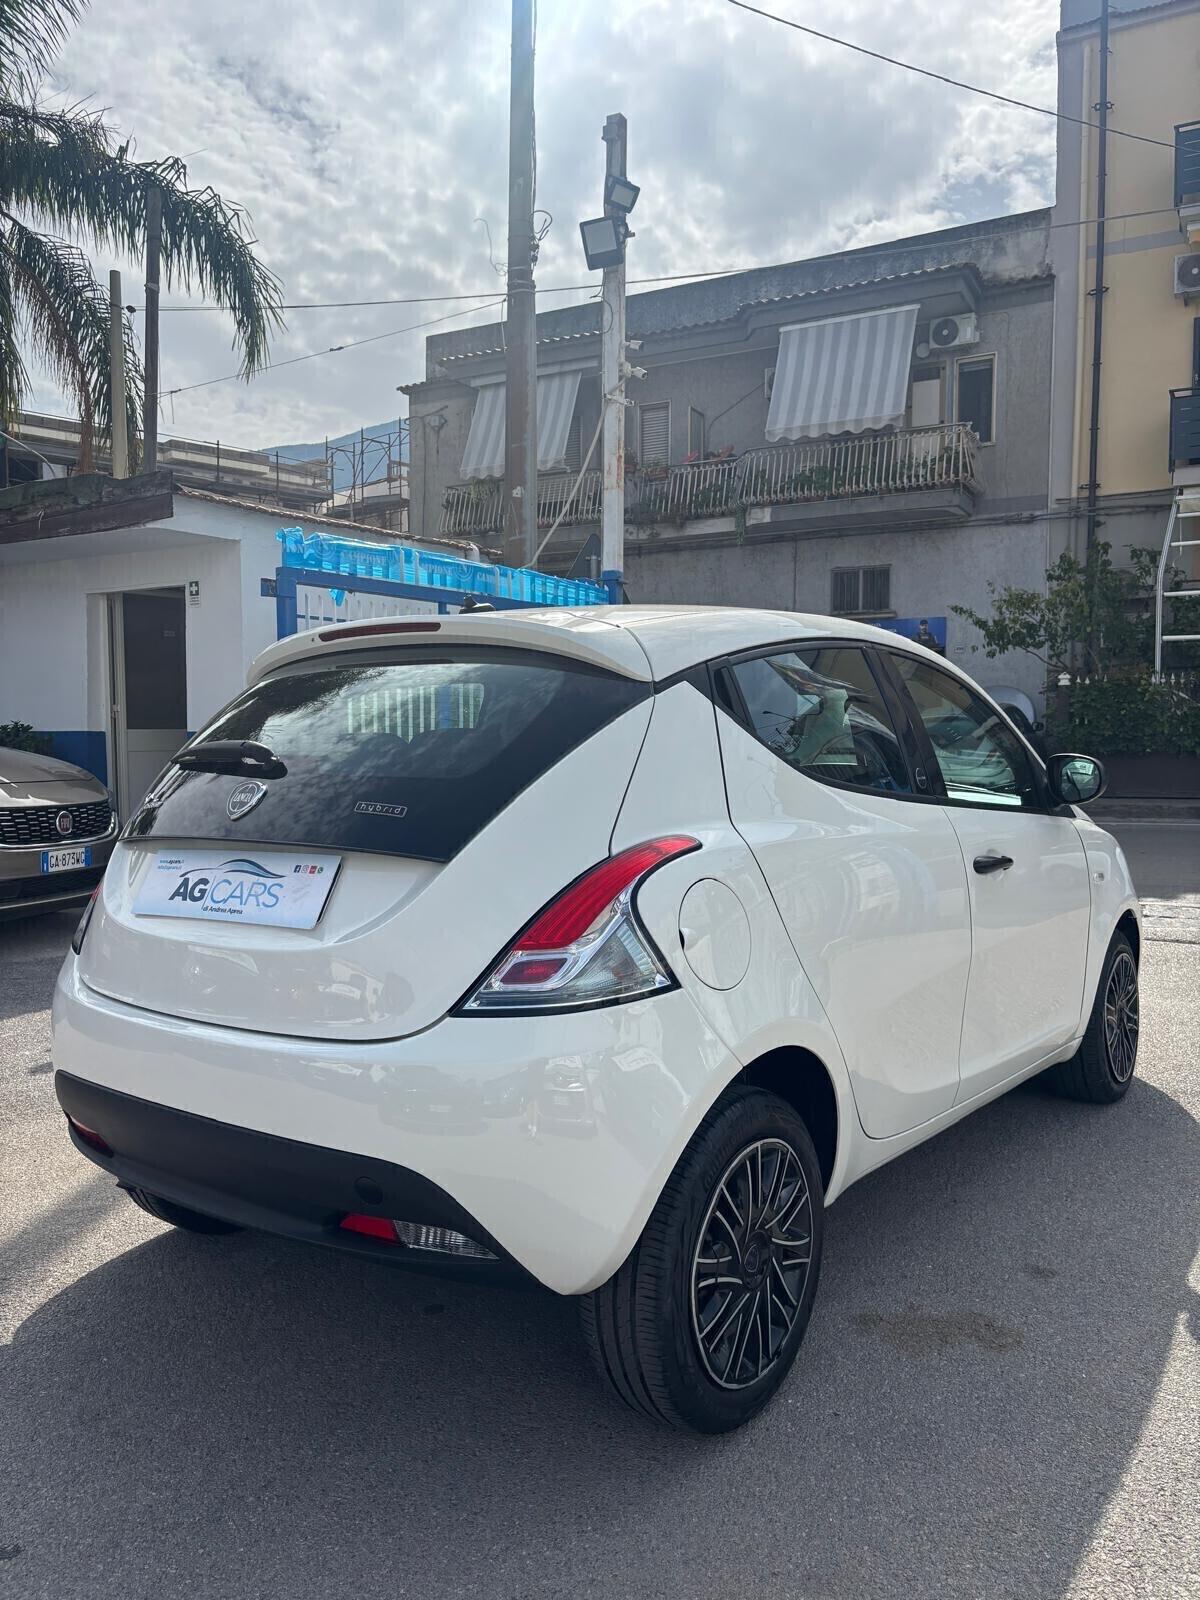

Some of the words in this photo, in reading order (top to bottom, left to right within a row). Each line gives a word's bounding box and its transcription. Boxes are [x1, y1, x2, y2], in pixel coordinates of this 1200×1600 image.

[360, 802, 402, 814] hybrid
[168, 876, 210, 902] AG
[210, 878, 284, 908] CARS
